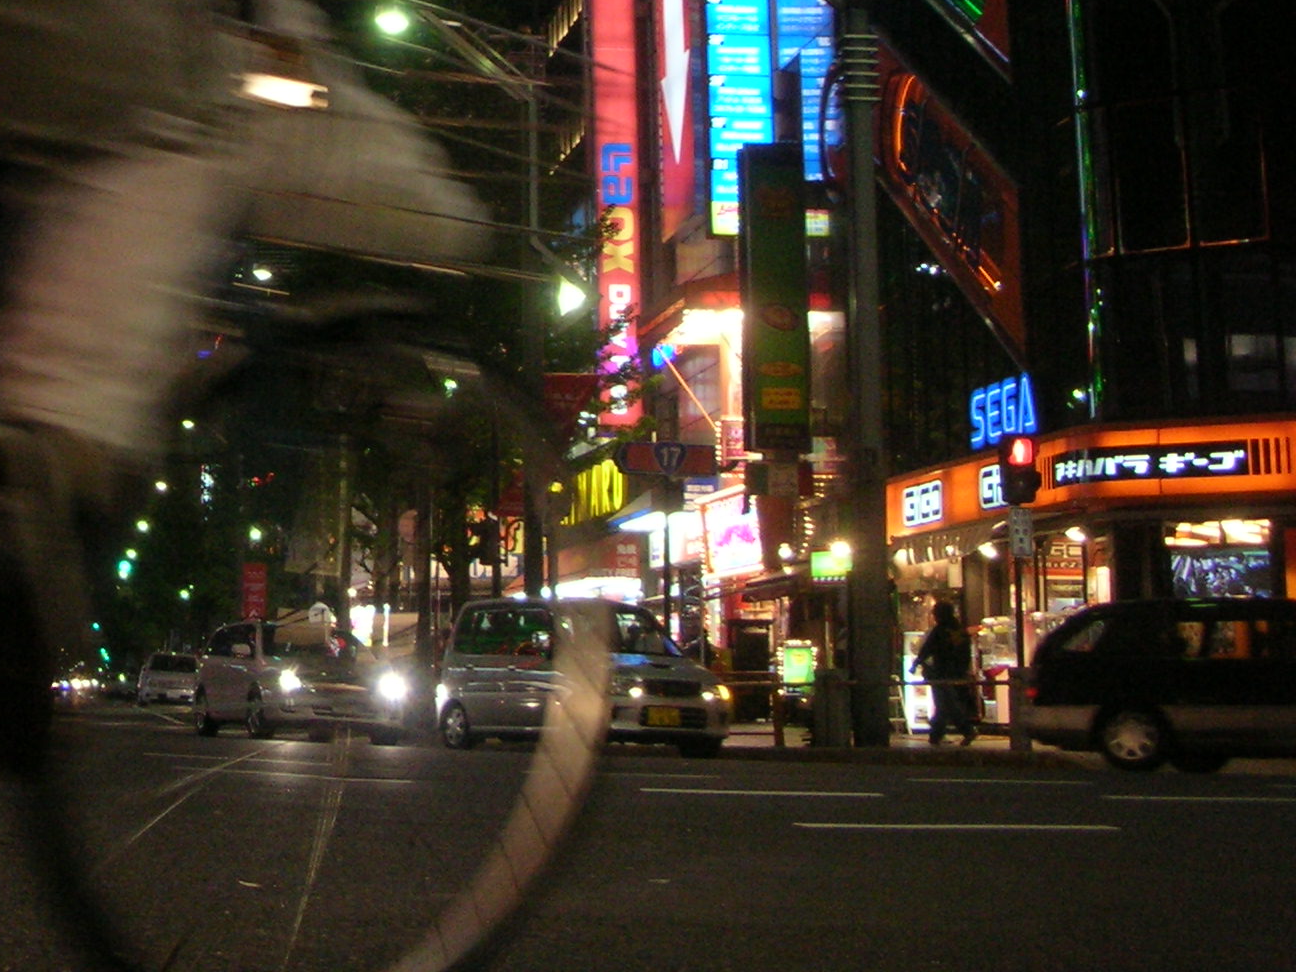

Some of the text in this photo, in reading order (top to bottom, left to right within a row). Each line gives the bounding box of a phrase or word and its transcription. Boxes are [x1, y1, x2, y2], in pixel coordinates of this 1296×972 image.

[971, 372, 1036, 449] SEGA
[660, 447, 681, 467] 17
[1158, 439, 1246, 474] ギーゴ
